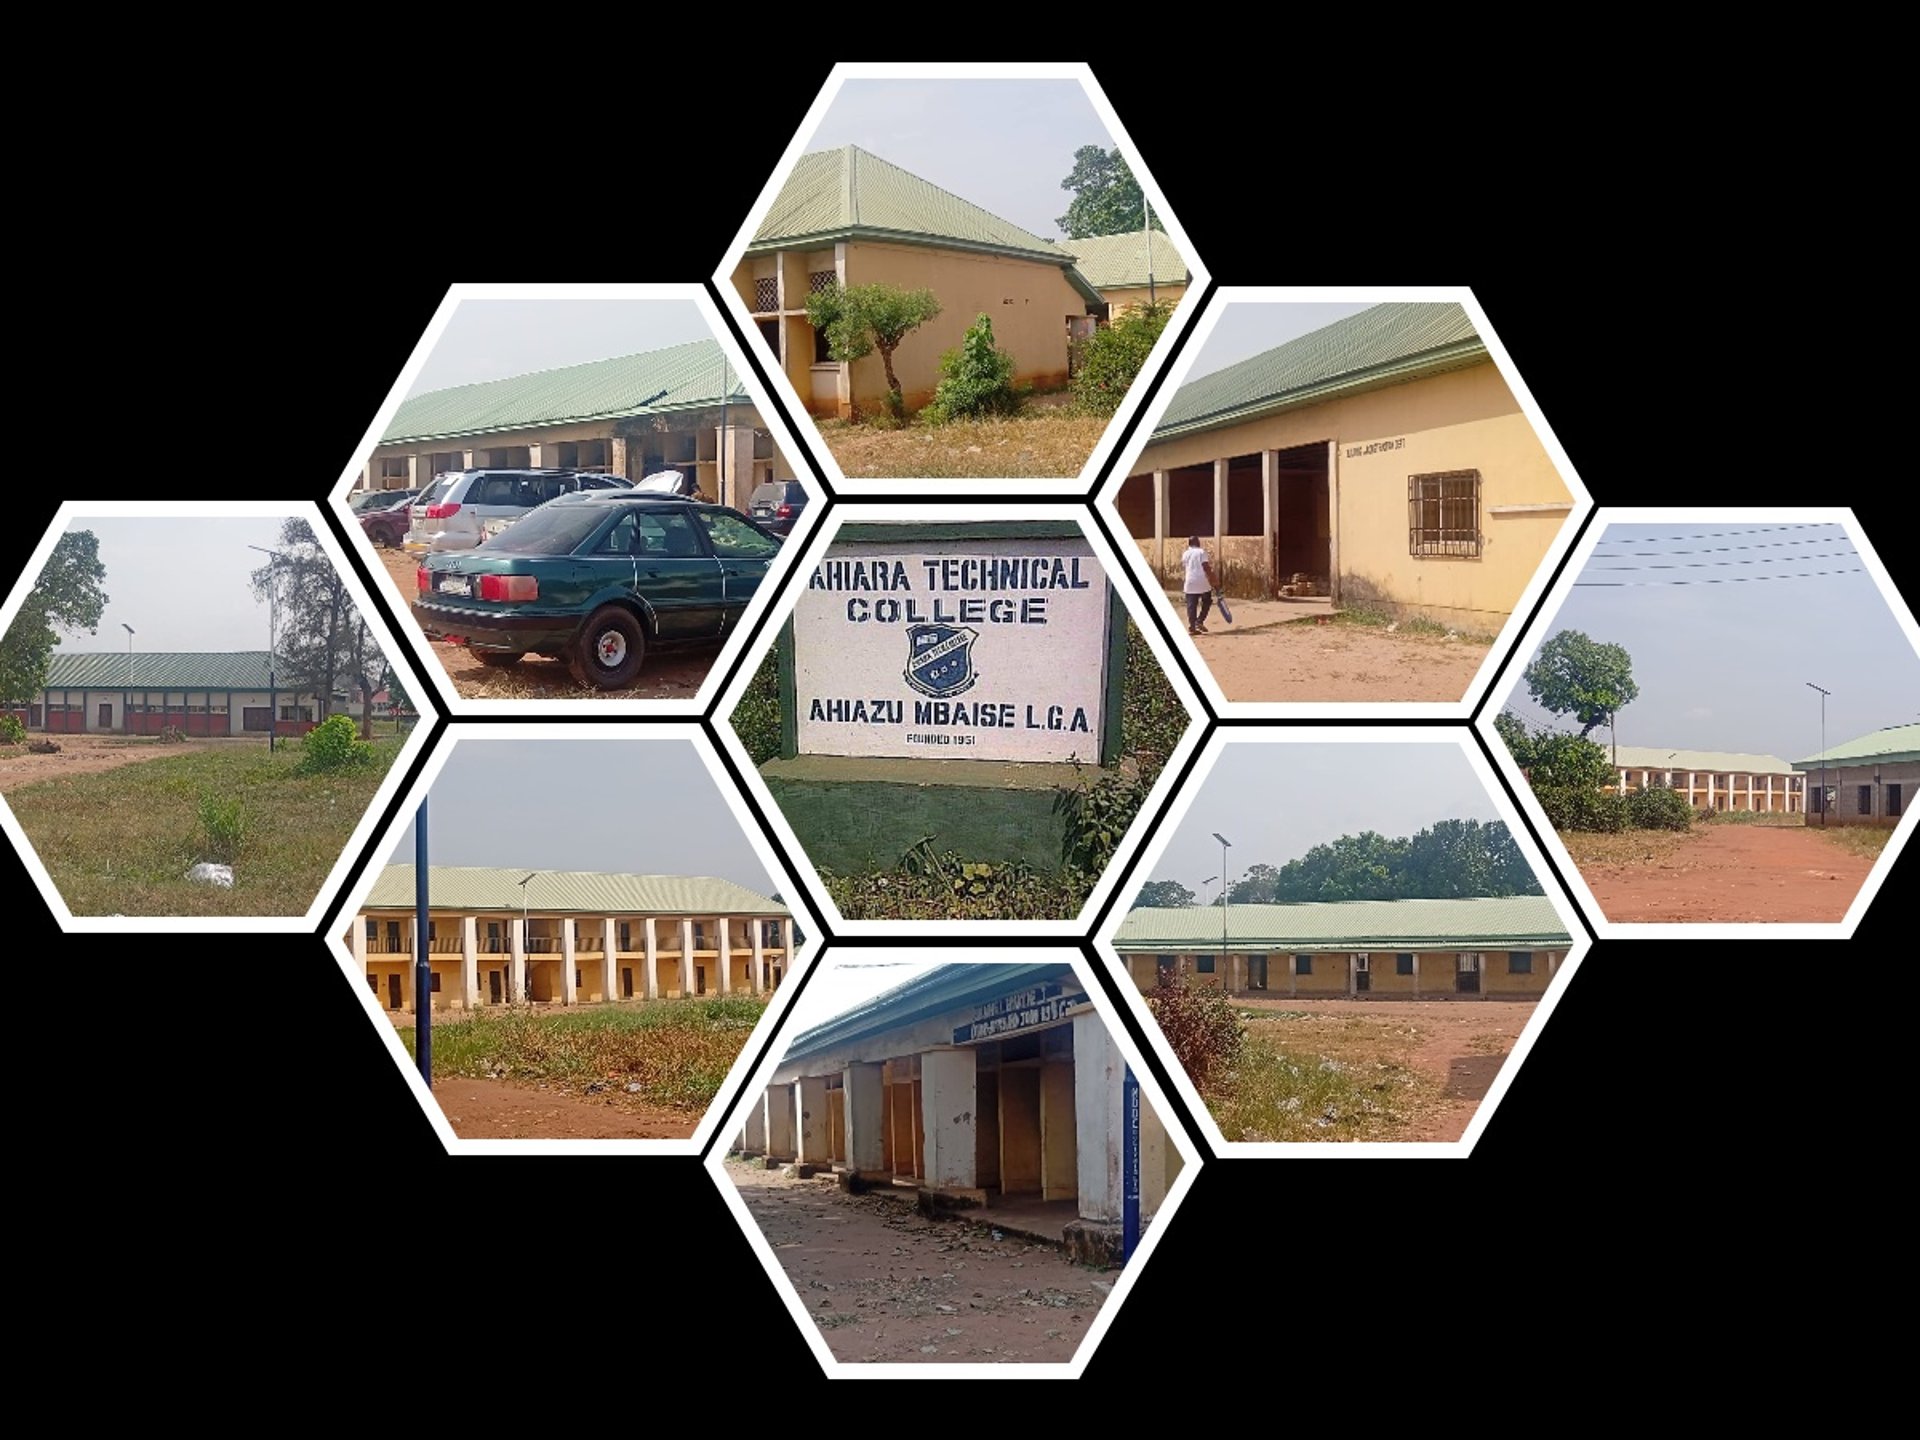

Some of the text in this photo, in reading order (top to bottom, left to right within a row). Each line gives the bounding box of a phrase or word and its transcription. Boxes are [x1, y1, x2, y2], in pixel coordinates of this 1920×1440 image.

[808, 557, 1090, 591] AHIARA TECHNICAL
[847, 597, 1049, 624] COLLEGE
[809, 699, 1094, 733] AHIAZU MBAISE L.G.A.
[906, 733, 950, 745] FOUNDED
